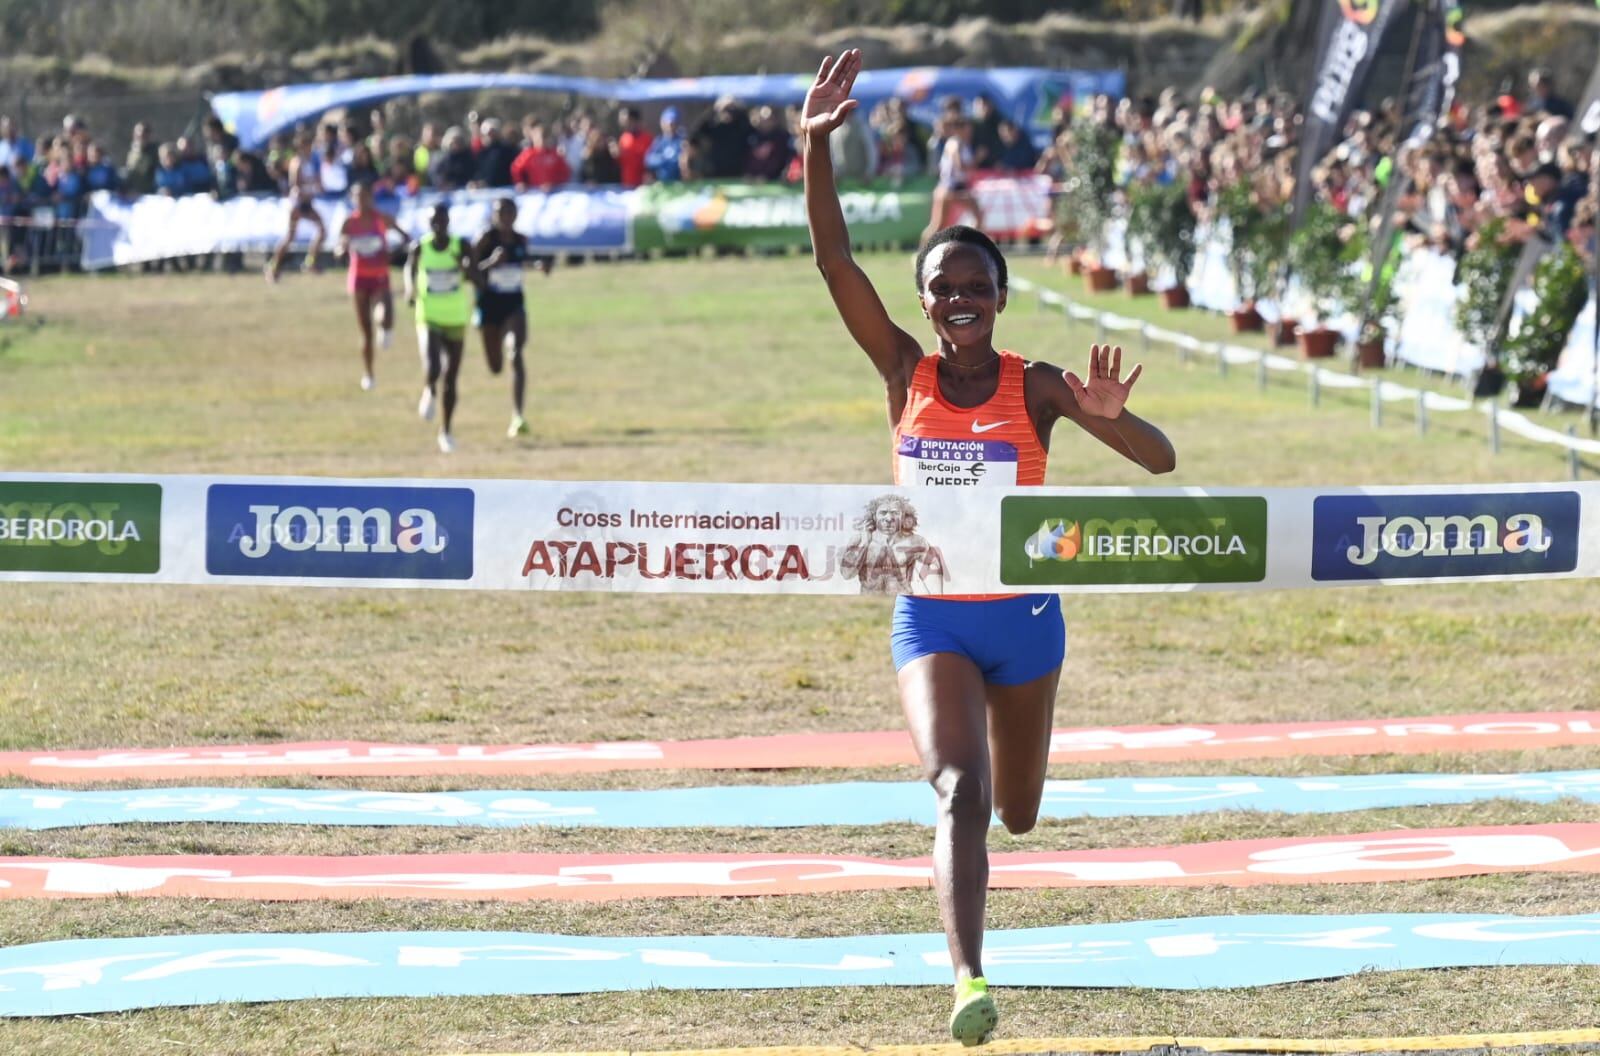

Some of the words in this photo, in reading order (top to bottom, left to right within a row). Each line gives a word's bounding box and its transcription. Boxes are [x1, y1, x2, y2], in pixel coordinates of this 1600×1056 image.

[921, 441, 985, 451] DIPUTACIÓN
[918, 461, 961, 474] iberCaja
[239, 504, 446, 558] Joma
[556, 507, 622, 529] Cross
[629, 508, 781, 531] Internacional
[1087, 533, 1247, 556] IBERDROLA
[1346, 512, 1552, 566] Joma
[521, 539, 810, 582] ATAPUERCA
